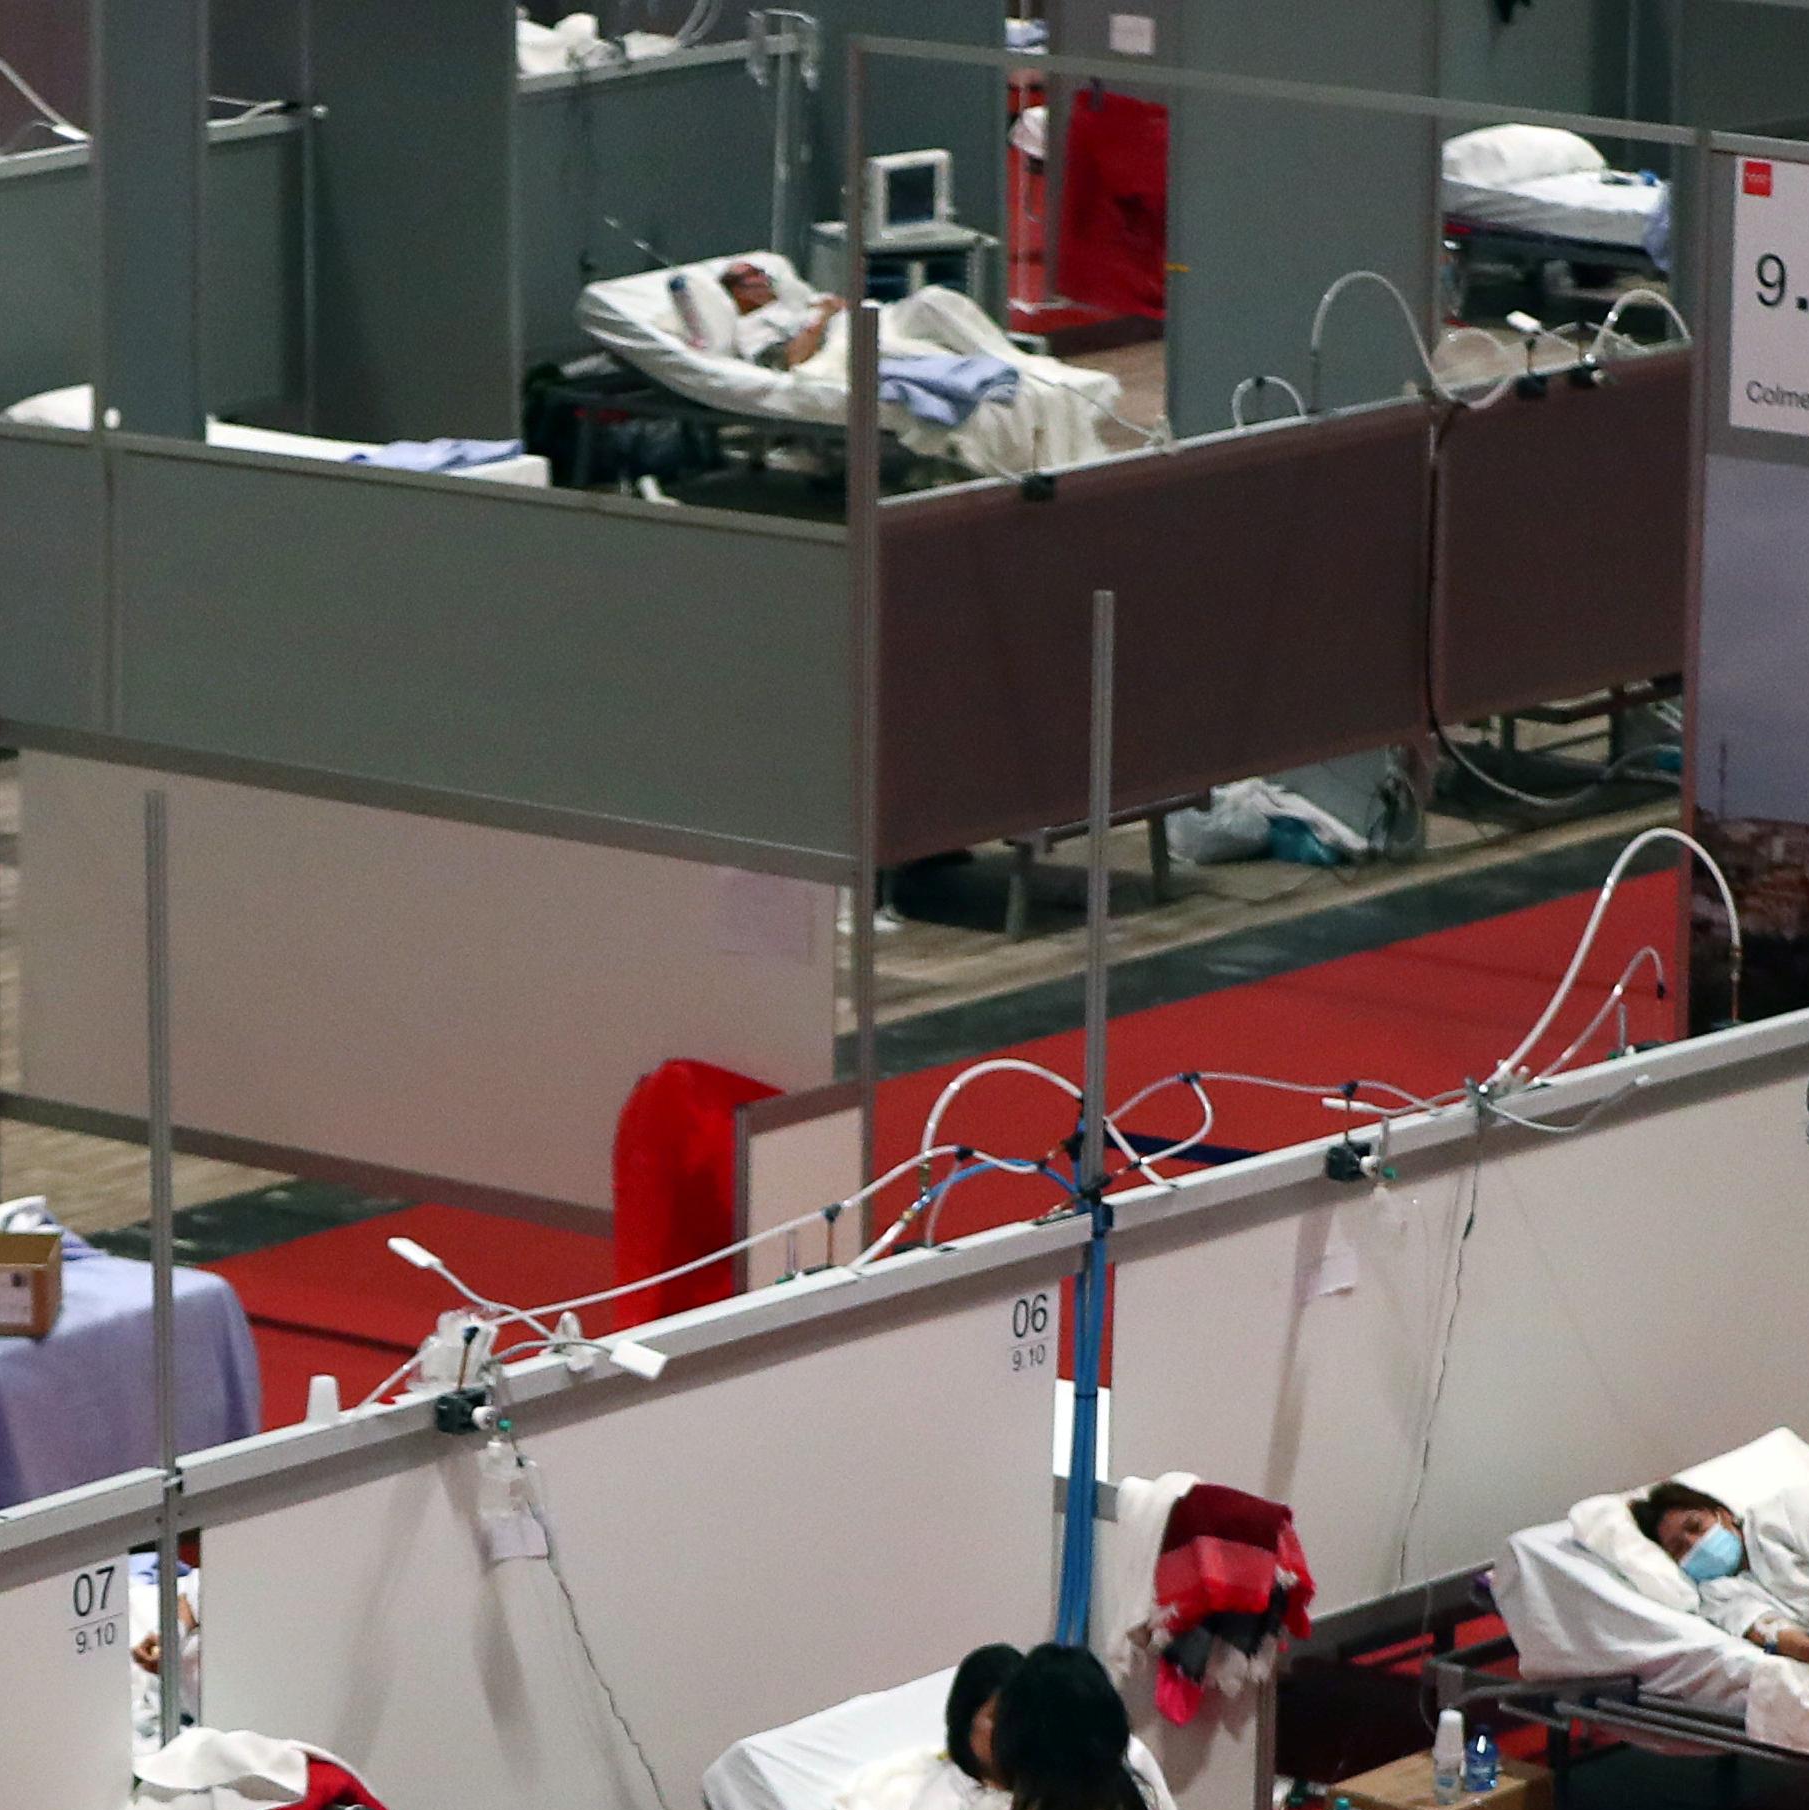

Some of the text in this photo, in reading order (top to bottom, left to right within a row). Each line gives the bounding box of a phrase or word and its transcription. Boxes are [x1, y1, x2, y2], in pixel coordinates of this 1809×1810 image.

[1013, 1294, 1047, 1338] 06
[1012, 1344, 1046, 1371] 9.10
[73, 1566, 115, 1616] 07
[75, 1622, 115, 1653] 9.10
